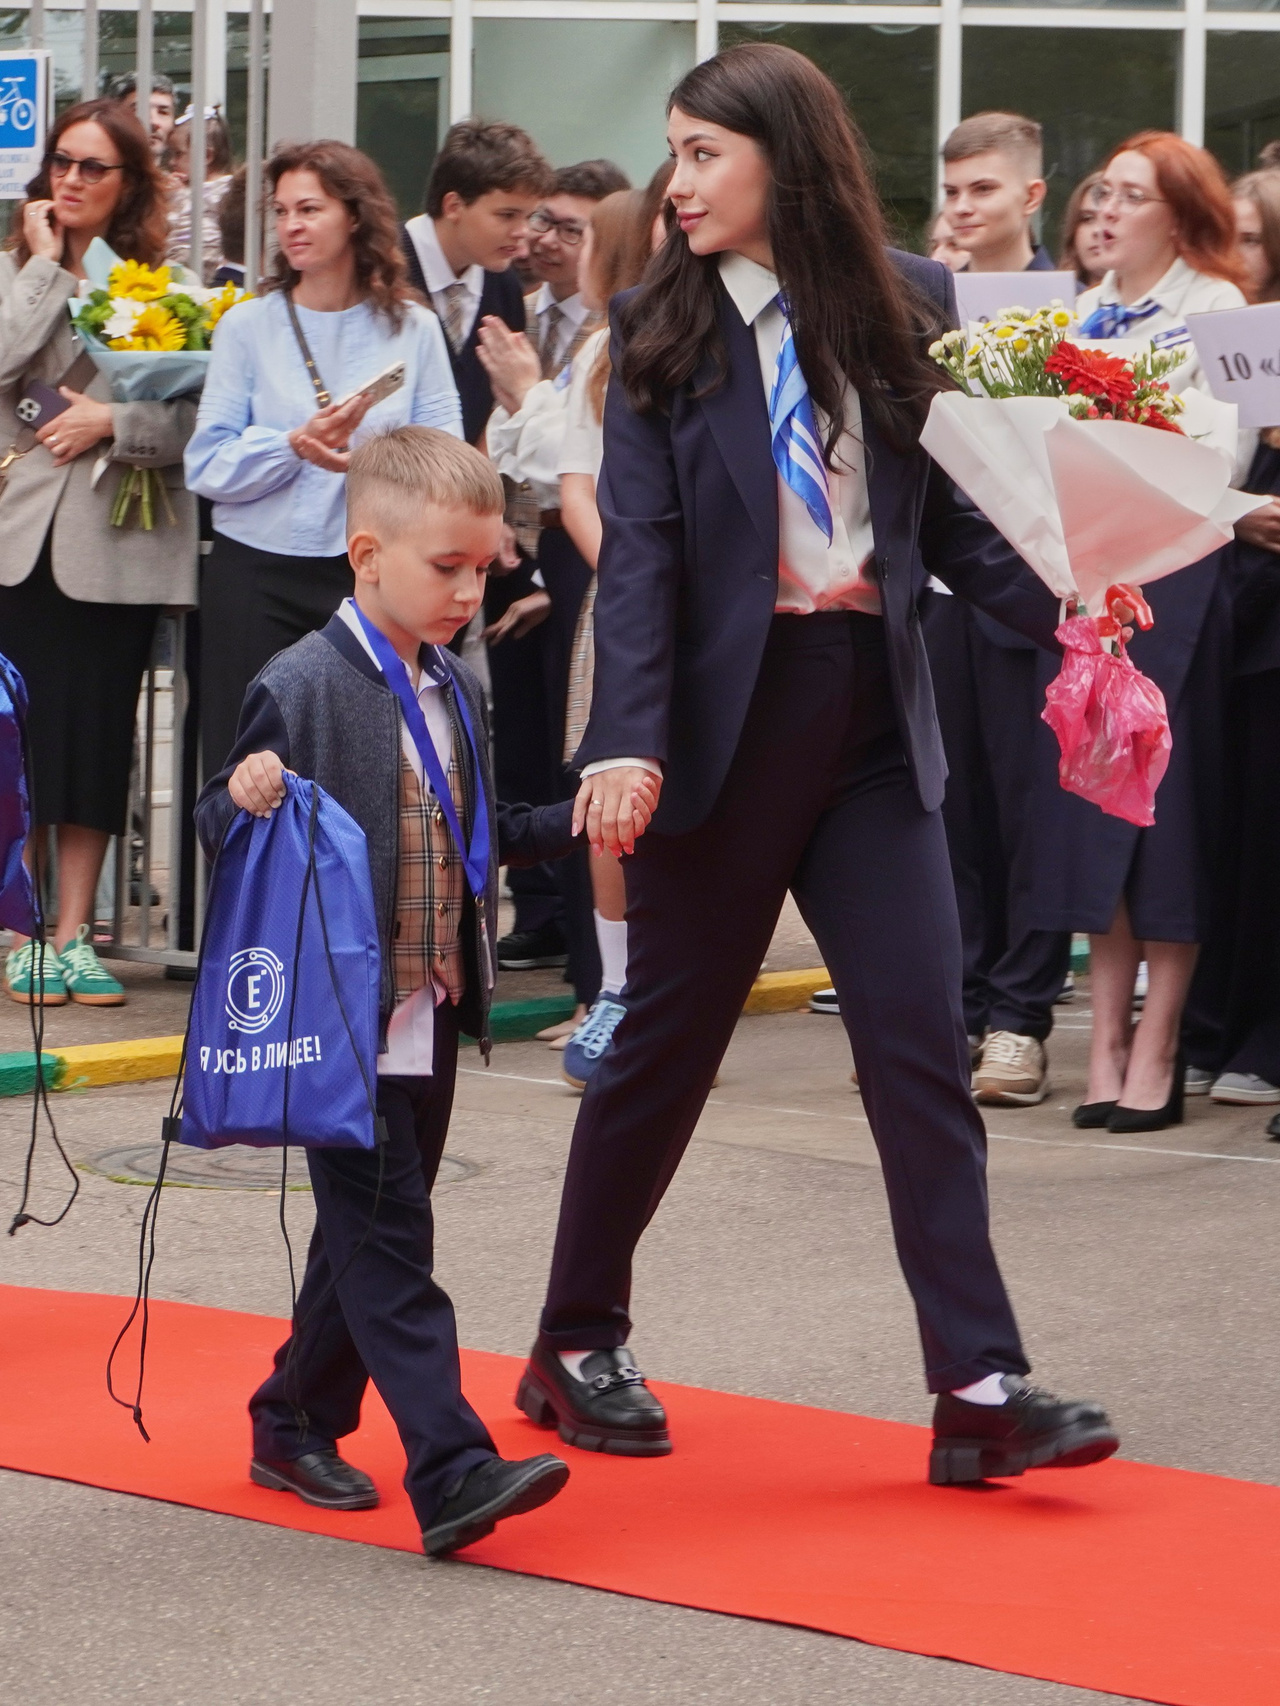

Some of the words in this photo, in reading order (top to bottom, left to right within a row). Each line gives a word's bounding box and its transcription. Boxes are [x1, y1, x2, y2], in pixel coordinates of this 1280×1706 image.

[1218, 352, 1252, 382] 10
[200, 1046, 211, 1072] Я
[251, 1046, 261, 1072] В
[263, 1035, 322, 1070] ЛИЦЕЕ!
